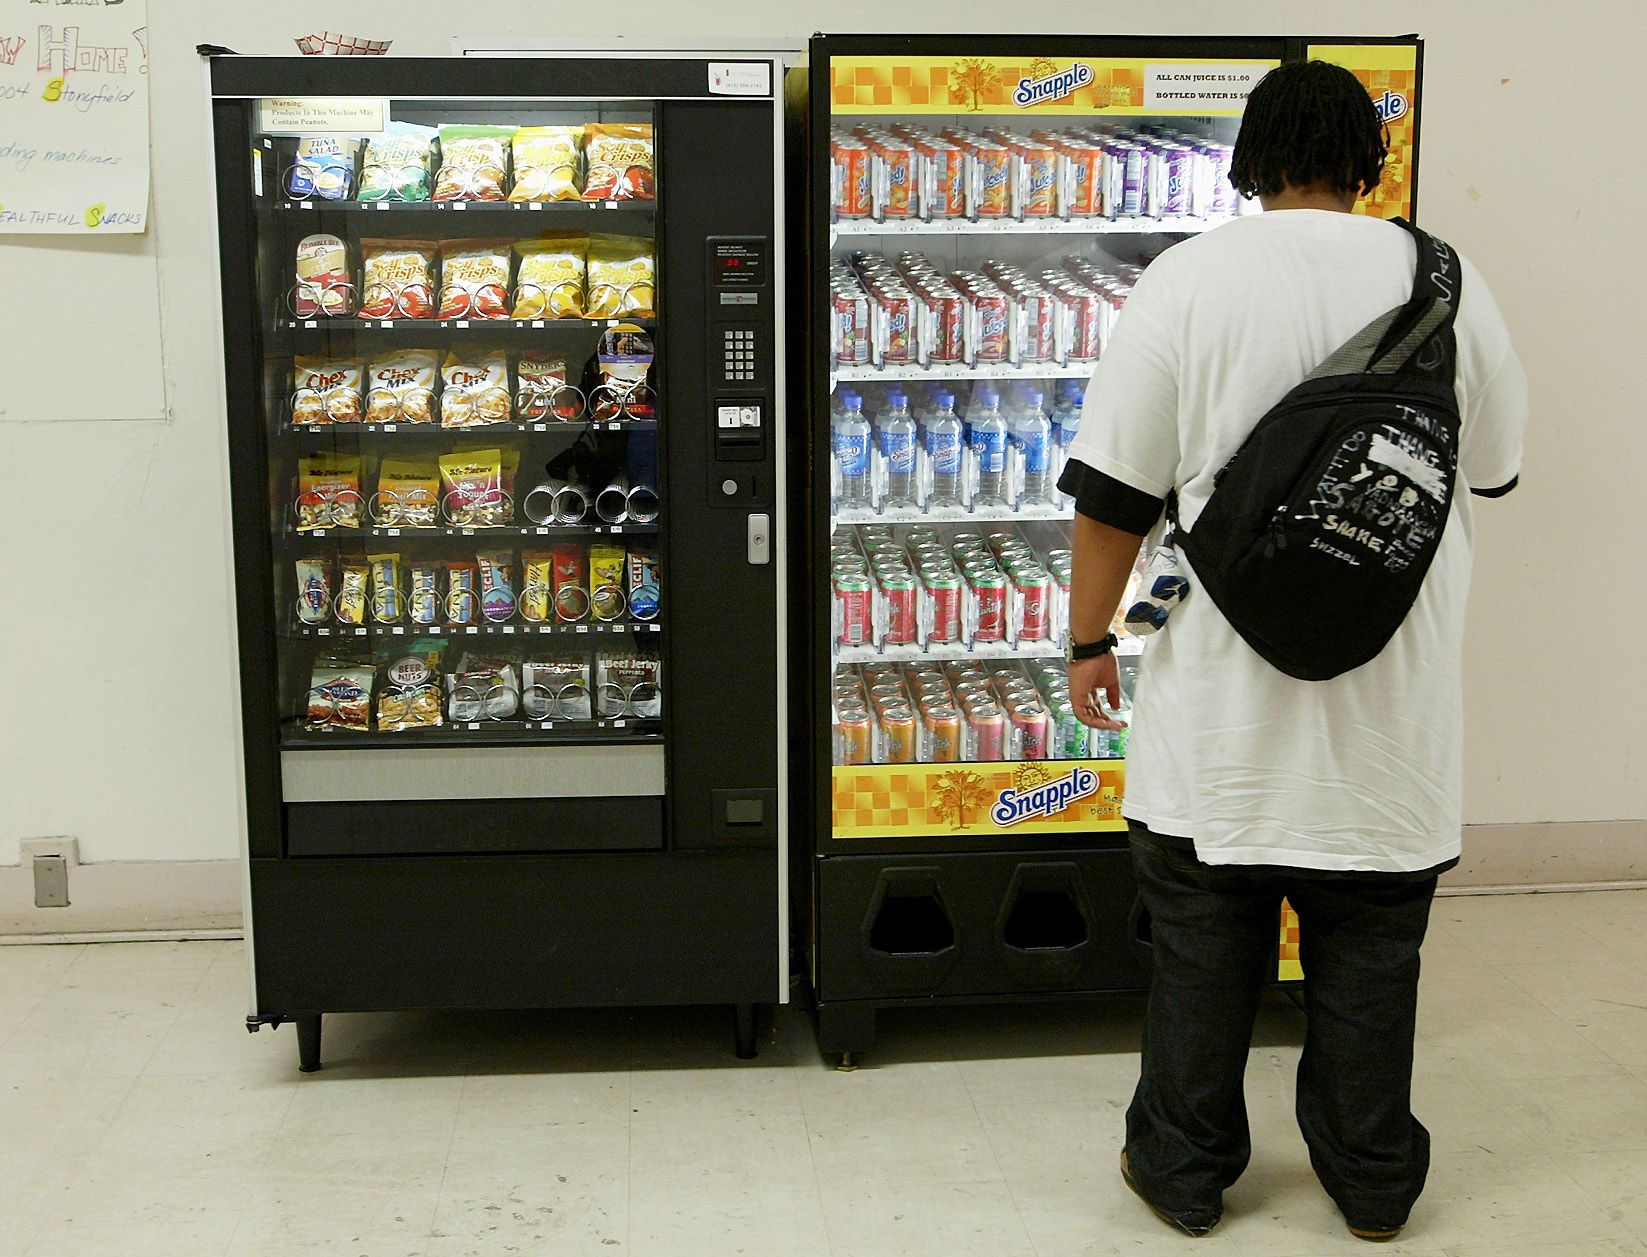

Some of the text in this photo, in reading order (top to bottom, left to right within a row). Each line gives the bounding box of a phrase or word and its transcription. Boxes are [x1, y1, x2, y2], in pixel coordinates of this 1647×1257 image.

[1017, 63, 1088, 102] Snapple
[311, 139, 336, 147] TUNA
[599, 142, 626, 153] Soy
[43, 149, 121, 165] machines
[308, 146, 339, 155] SALAD
[600, 150, 650, 163] Crisps
[377, 265, 425, 280] Crisps
[306, 369, 348, 388] Chex
[377, 367, 421, 381] Chex
[387, 377, 415, 388] MIX
[398, 664, 422, 673] BEER
[605, 659, 659, 672] Beef Jerky
[398, 672, 422, 682] NUTS
[997, 768, 1091, 821] Snapple
